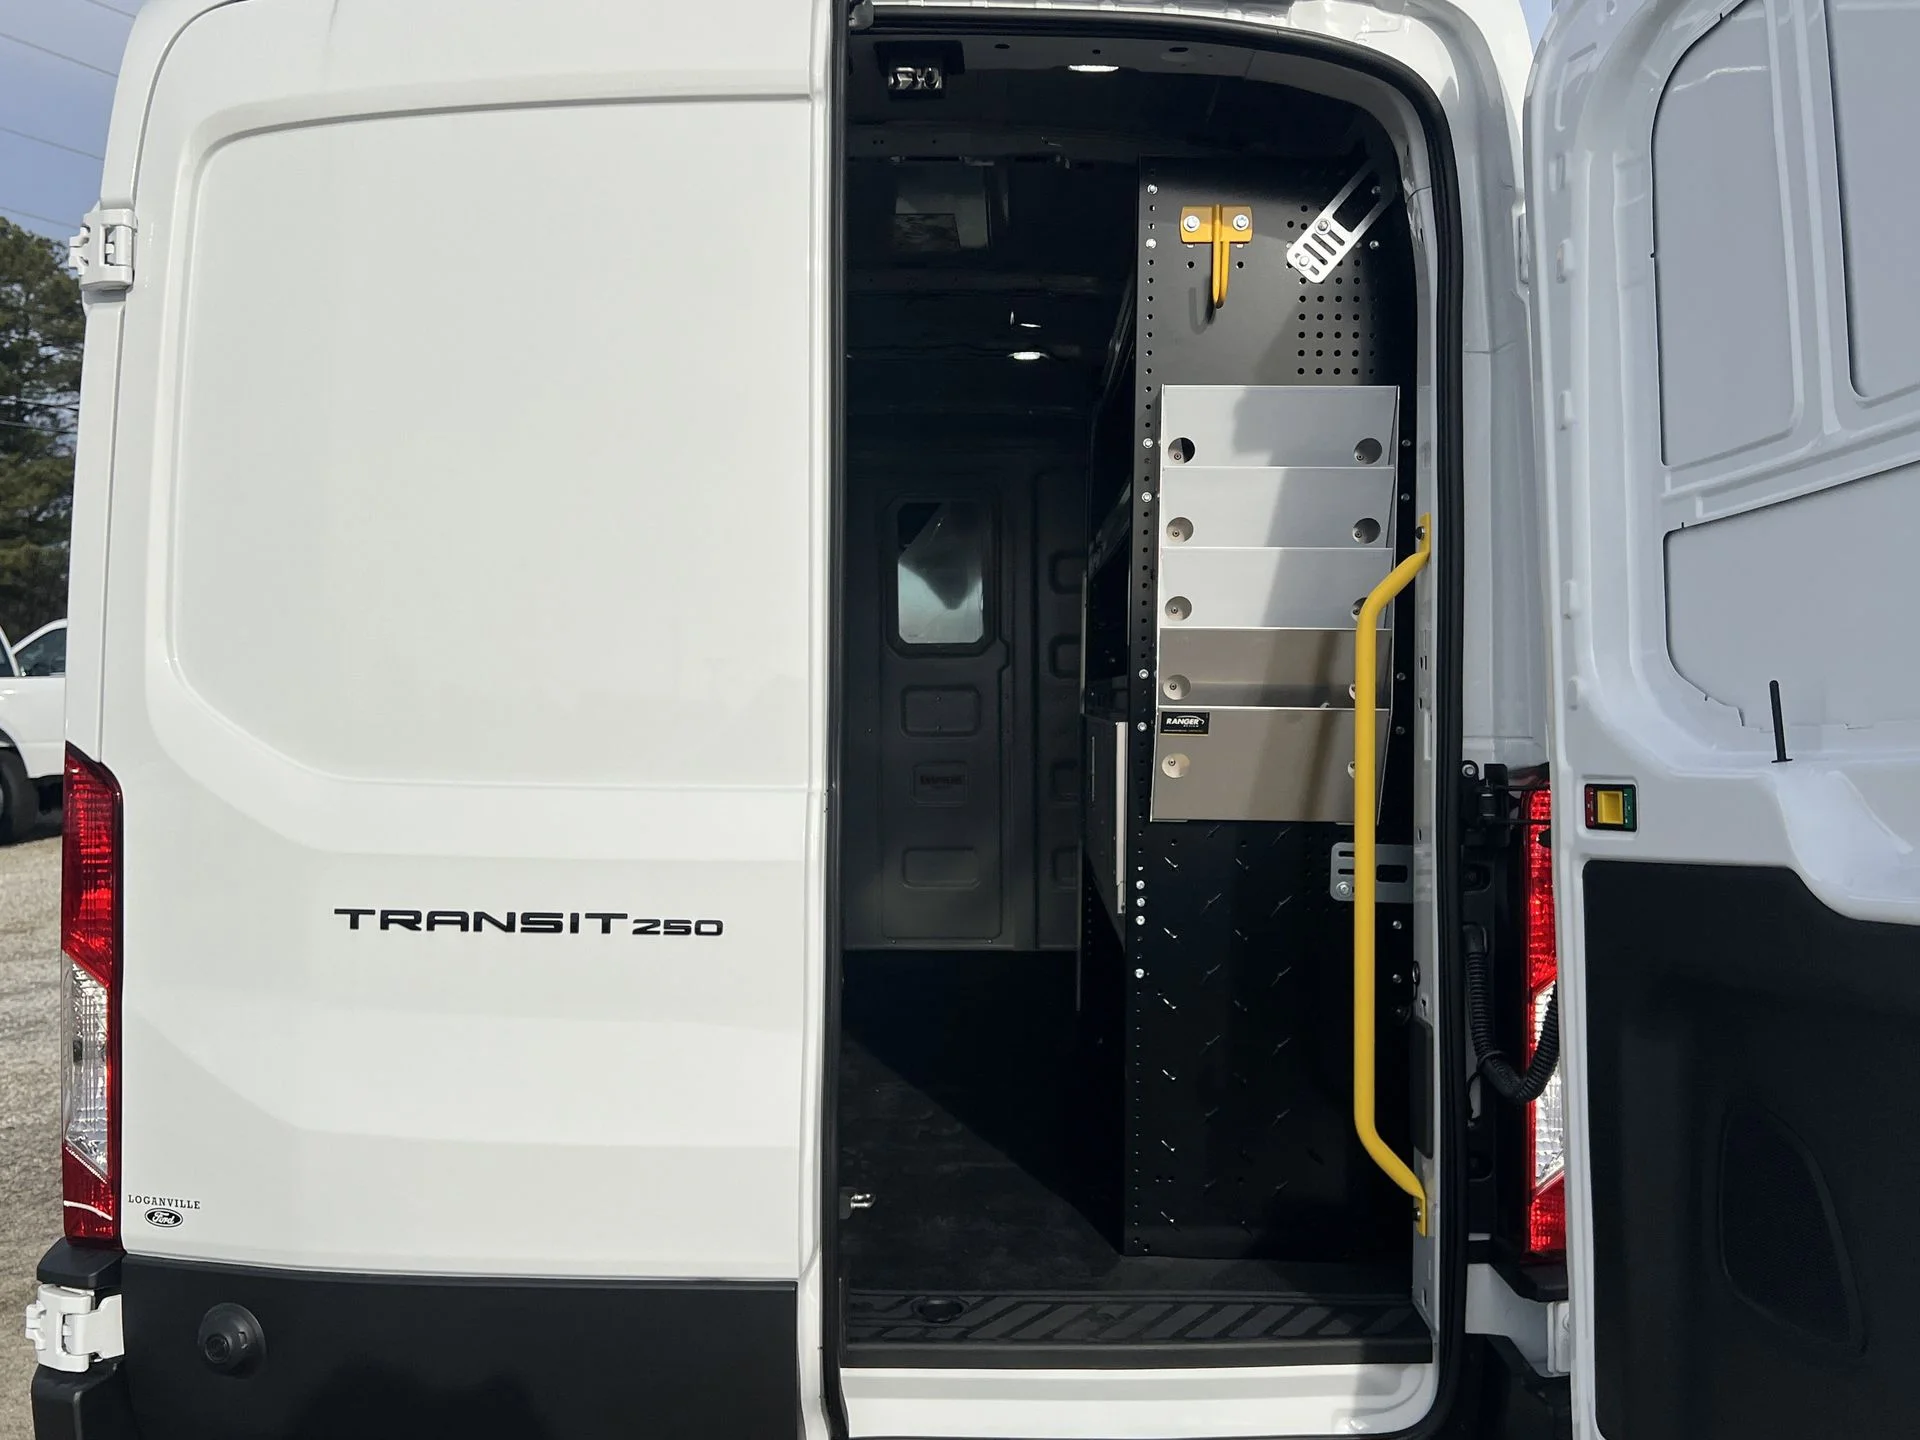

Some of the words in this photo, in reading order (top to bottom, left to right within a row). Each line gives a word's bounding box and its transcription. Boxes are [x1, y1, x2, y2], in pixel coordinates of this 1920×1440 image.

[334, 908, 628, 934] TRANSIT
[632, 919, 723, 936] 250
[128, 1195, 200, 1209] LOGANVILLE
[152, 1211, 175, 1224] Ford
